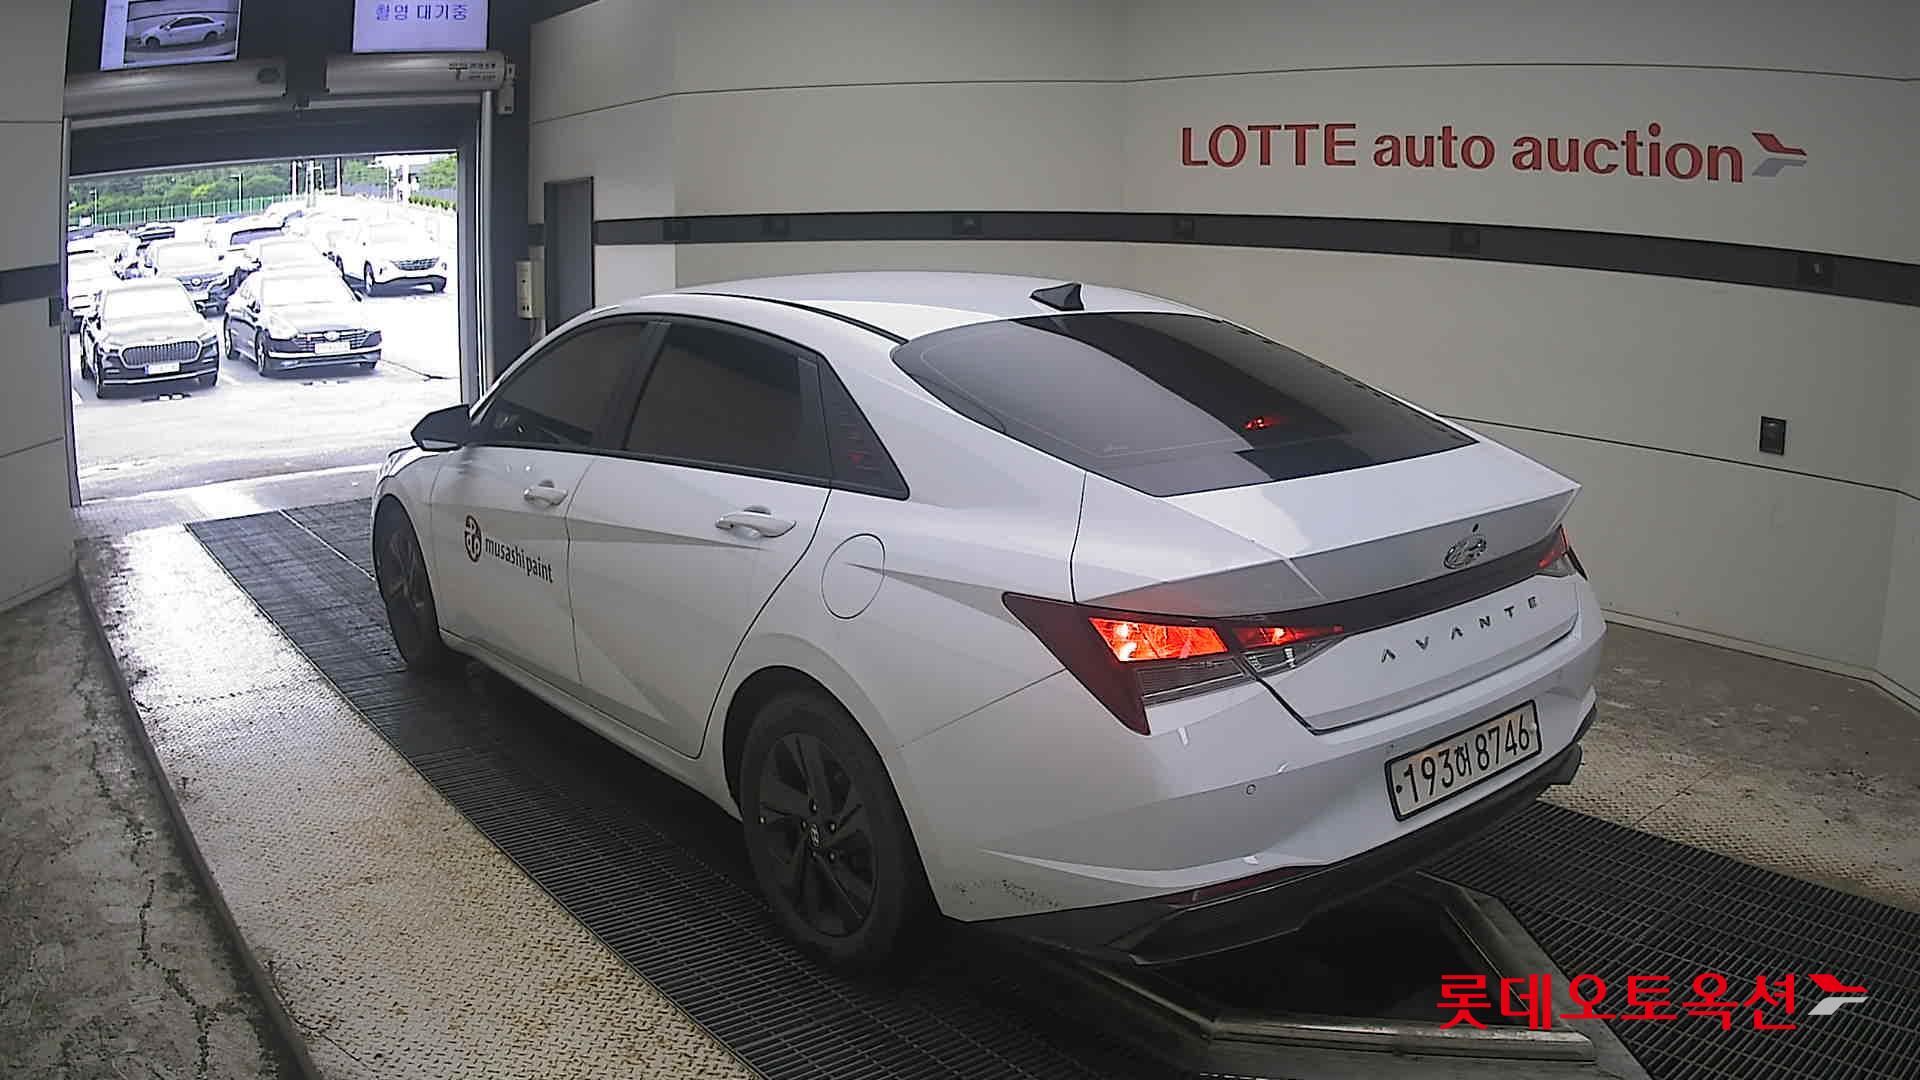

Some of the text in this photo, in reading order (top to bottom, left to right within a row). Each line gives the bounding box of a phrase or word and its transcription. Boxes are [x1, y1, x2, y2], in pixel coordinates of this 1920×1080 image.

[1182, 122, 1744, 183] LOTTE auto auction
[1381, 596, 1538, 663] AVANTE
